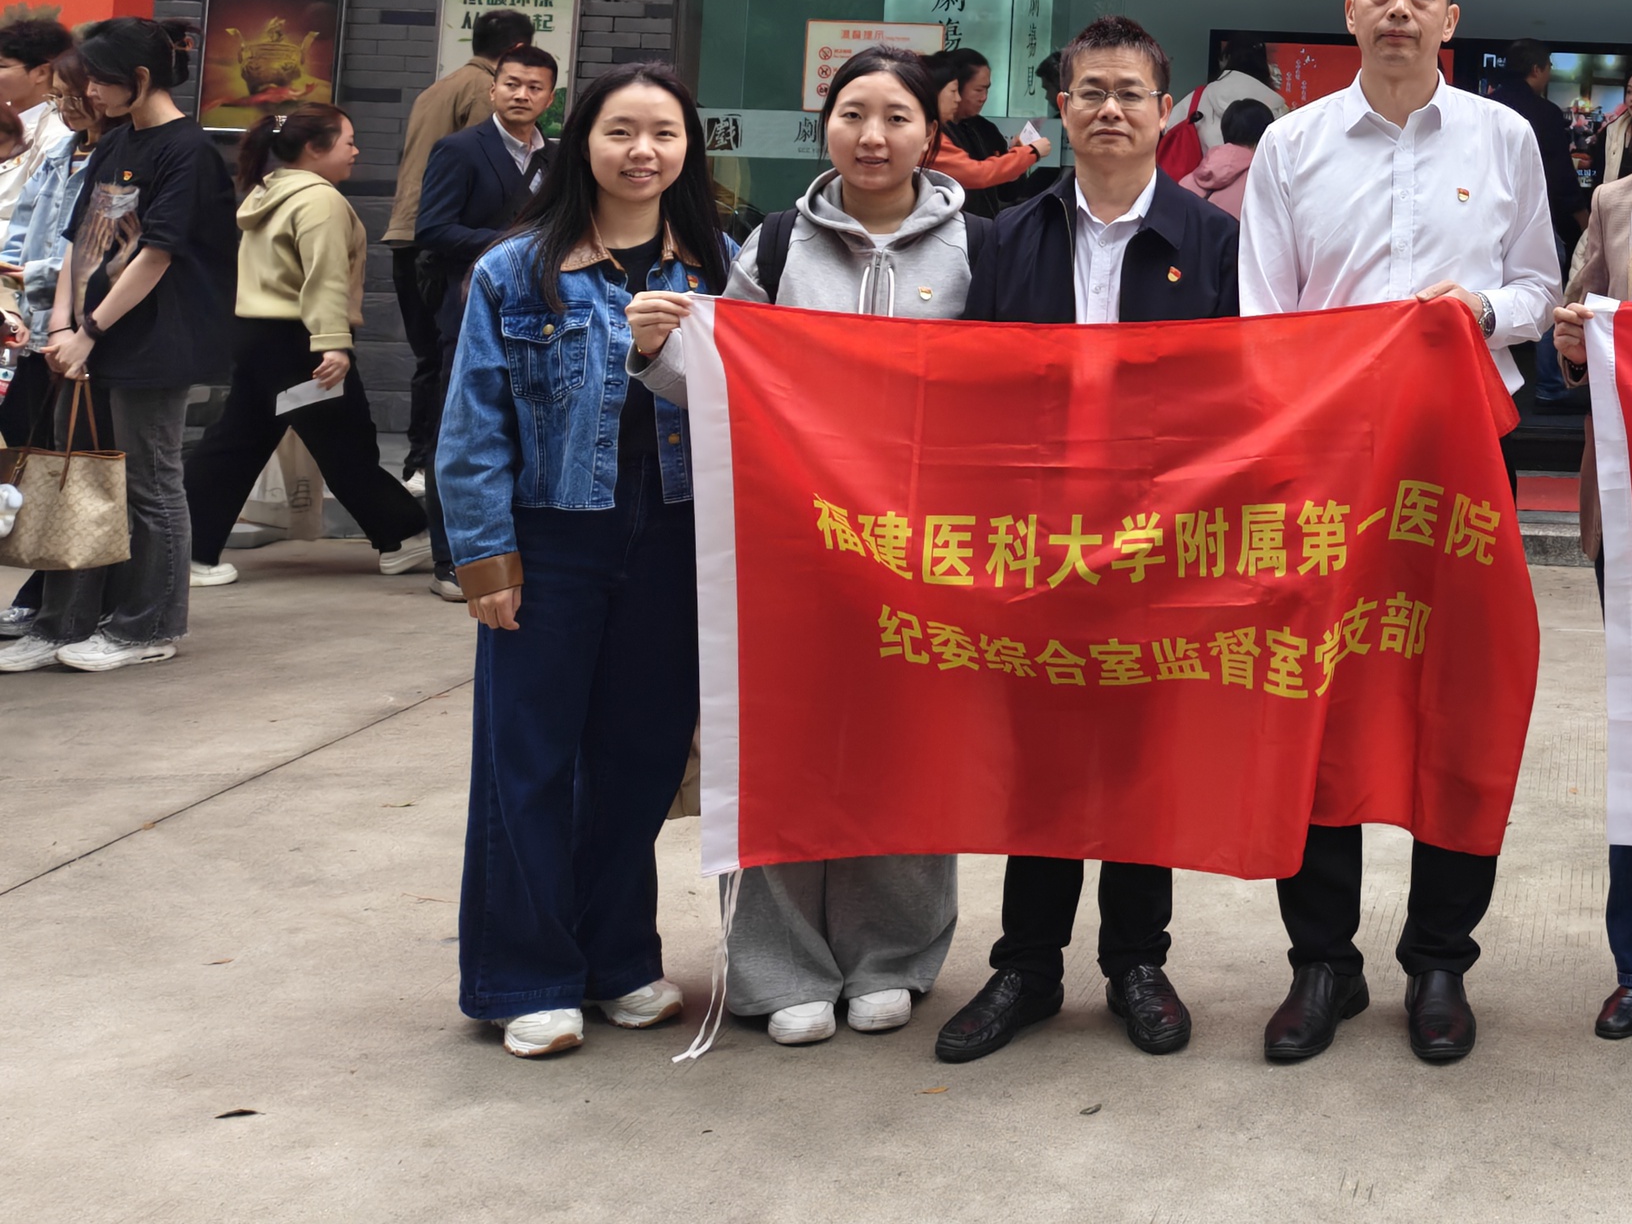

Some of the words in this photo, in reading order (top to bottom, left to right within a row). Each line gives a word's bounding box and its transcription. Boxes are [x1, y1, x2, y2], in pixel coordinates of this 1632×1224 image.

[813, 478, 1502, 589] 福建医科大学附属第一医院
